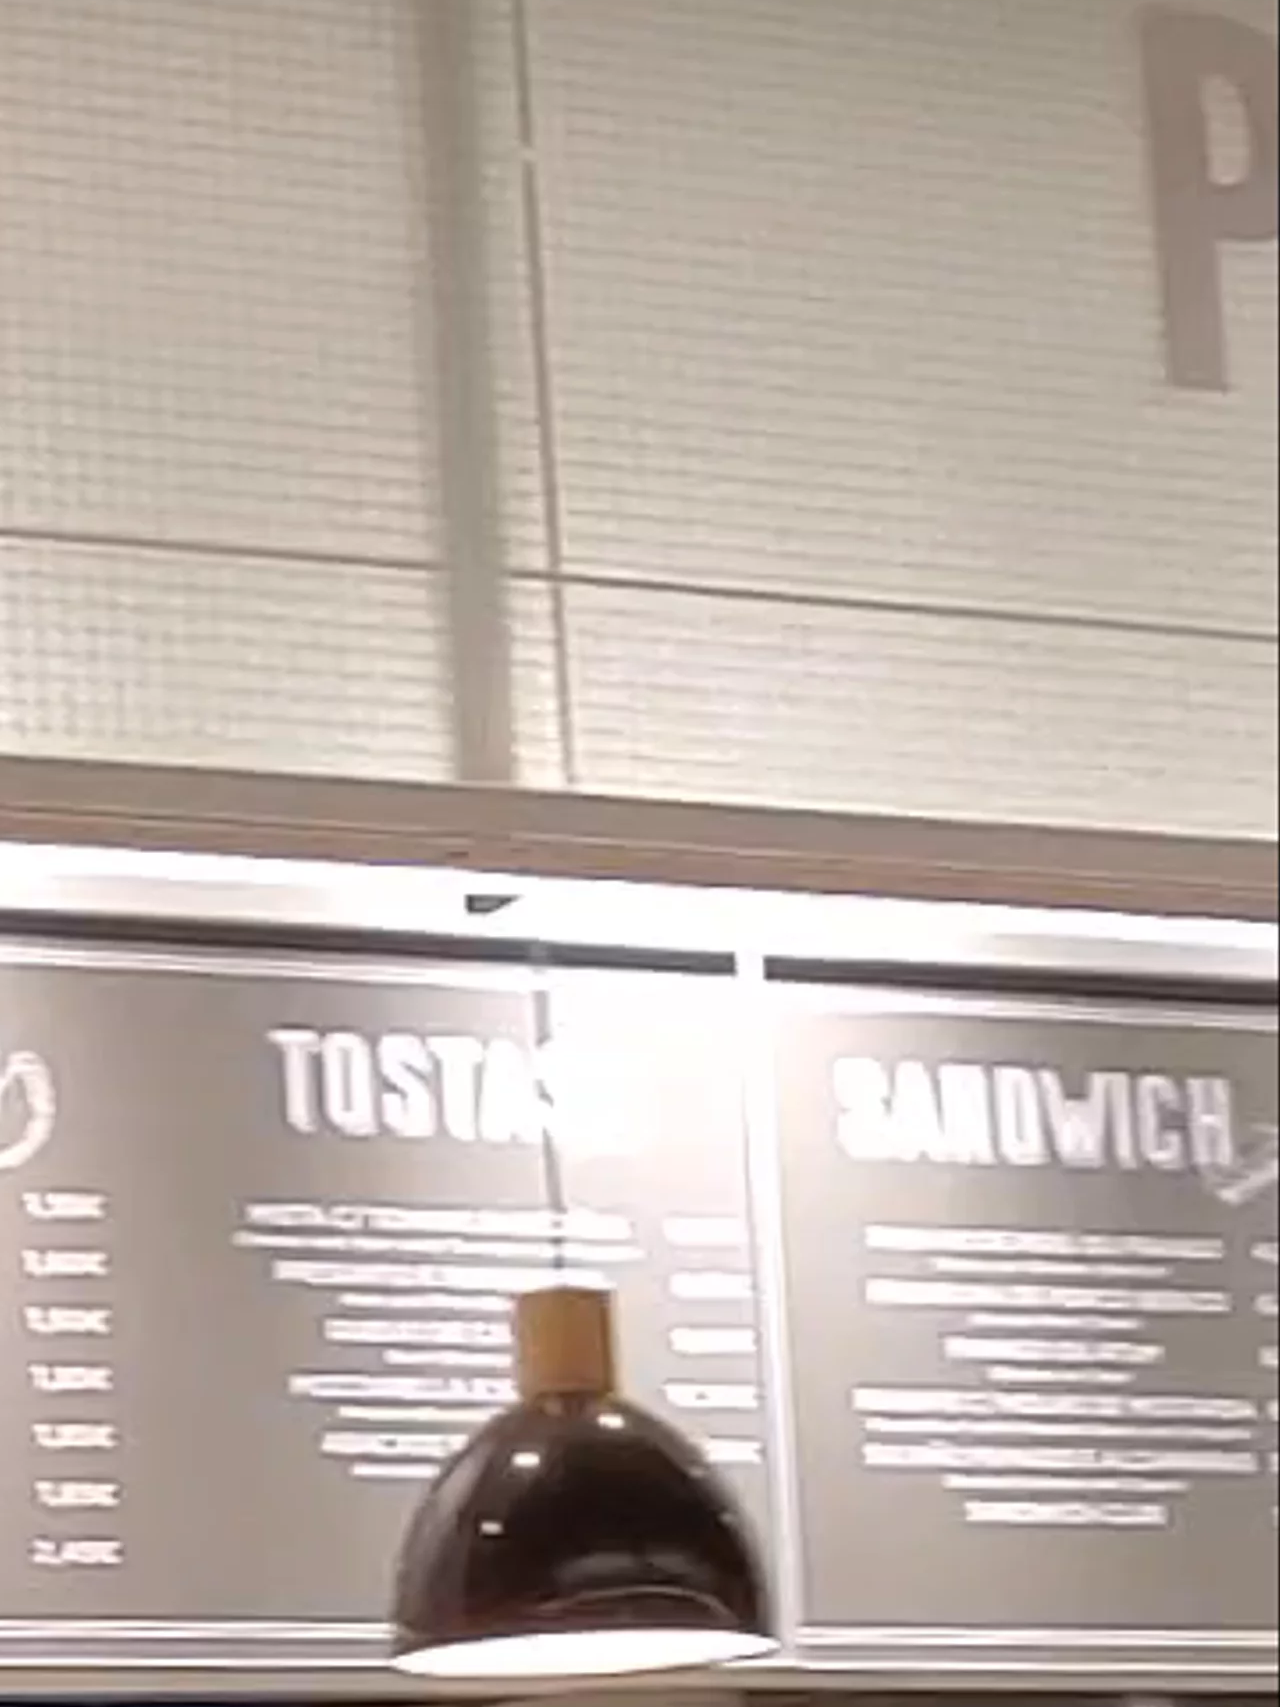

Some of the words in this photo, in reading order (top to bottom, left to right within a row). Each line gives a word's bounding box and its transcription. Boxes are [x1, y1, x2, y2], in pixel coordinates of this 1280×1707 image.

[1140, 7, 1276, 392] P
[272, 1030, 590, 1143] TOSTA
[833, 1057, 1233, 1169] SANDWICH
